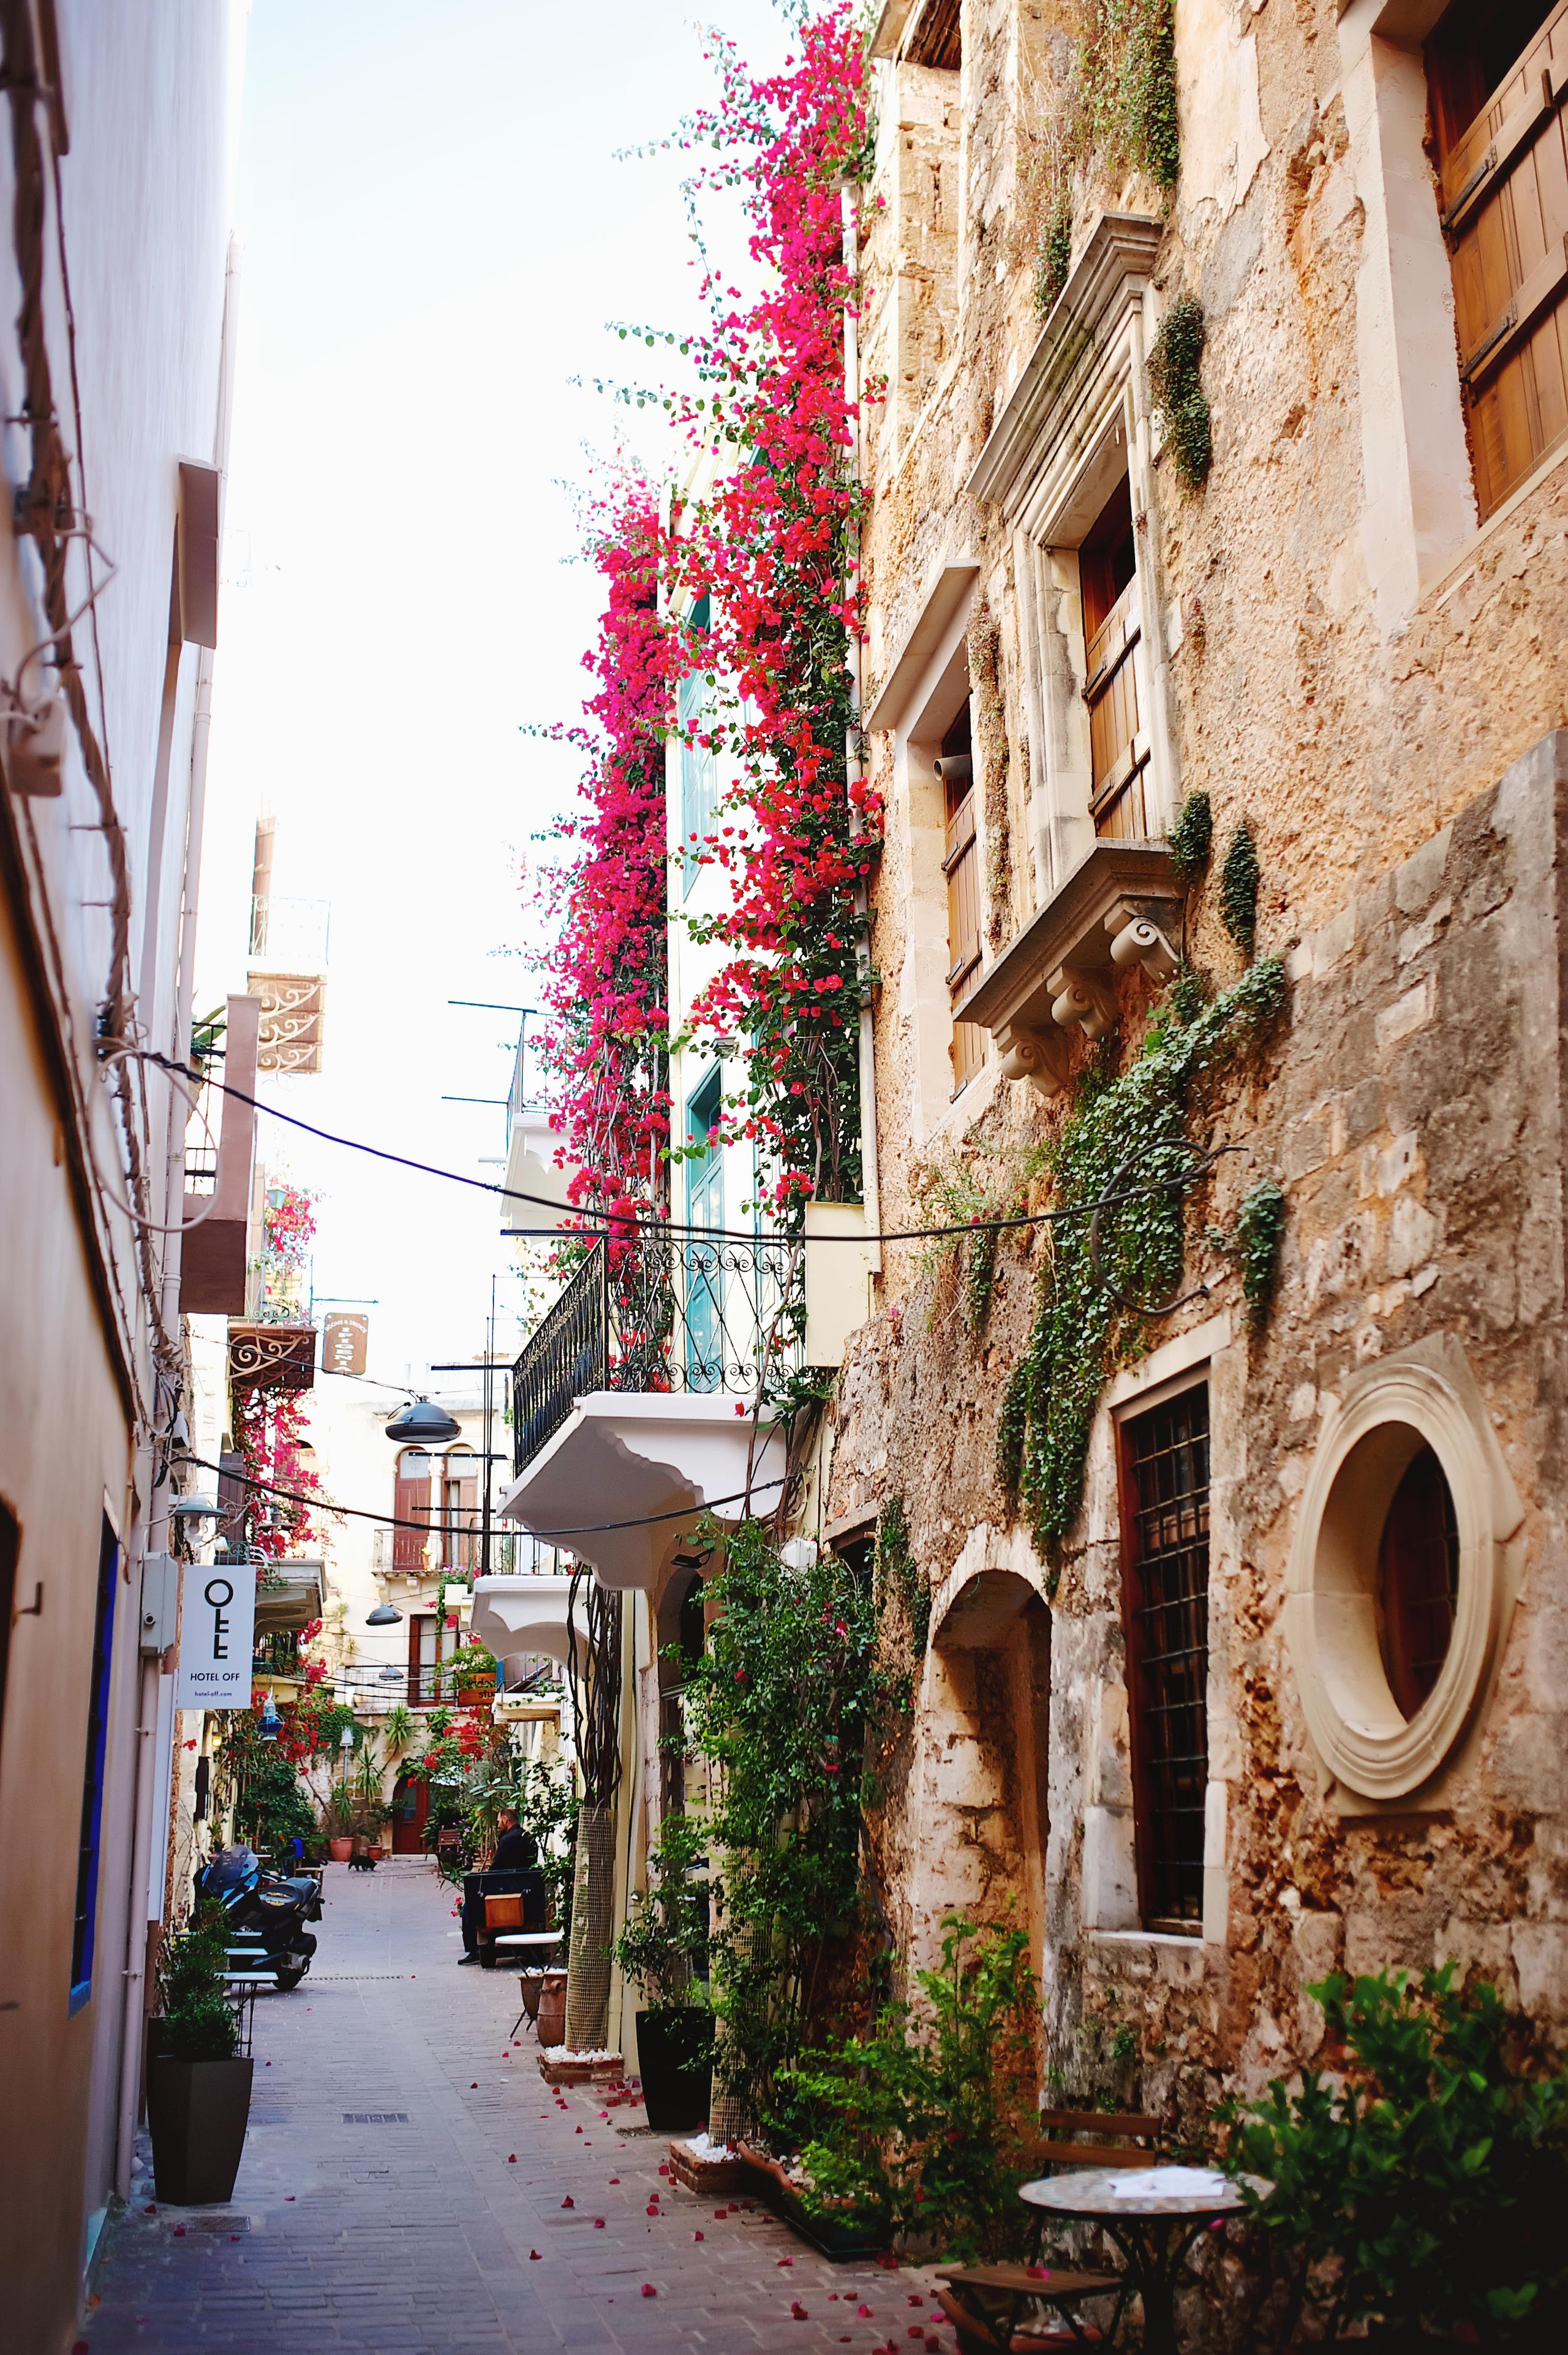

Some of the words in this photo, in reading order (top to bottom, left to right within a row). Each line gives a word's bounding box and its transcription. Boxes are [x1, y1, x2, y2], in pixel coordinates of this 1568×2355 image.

[325, 1319, 344, 1332] ROOMS
[333, 1327, 355, 1371] IFIGENIA
[190, 1673, 219, 1681] HOTEL
[222, 1673, 240, 1681] OFF
[478, 1690, 496, 1698] stu
